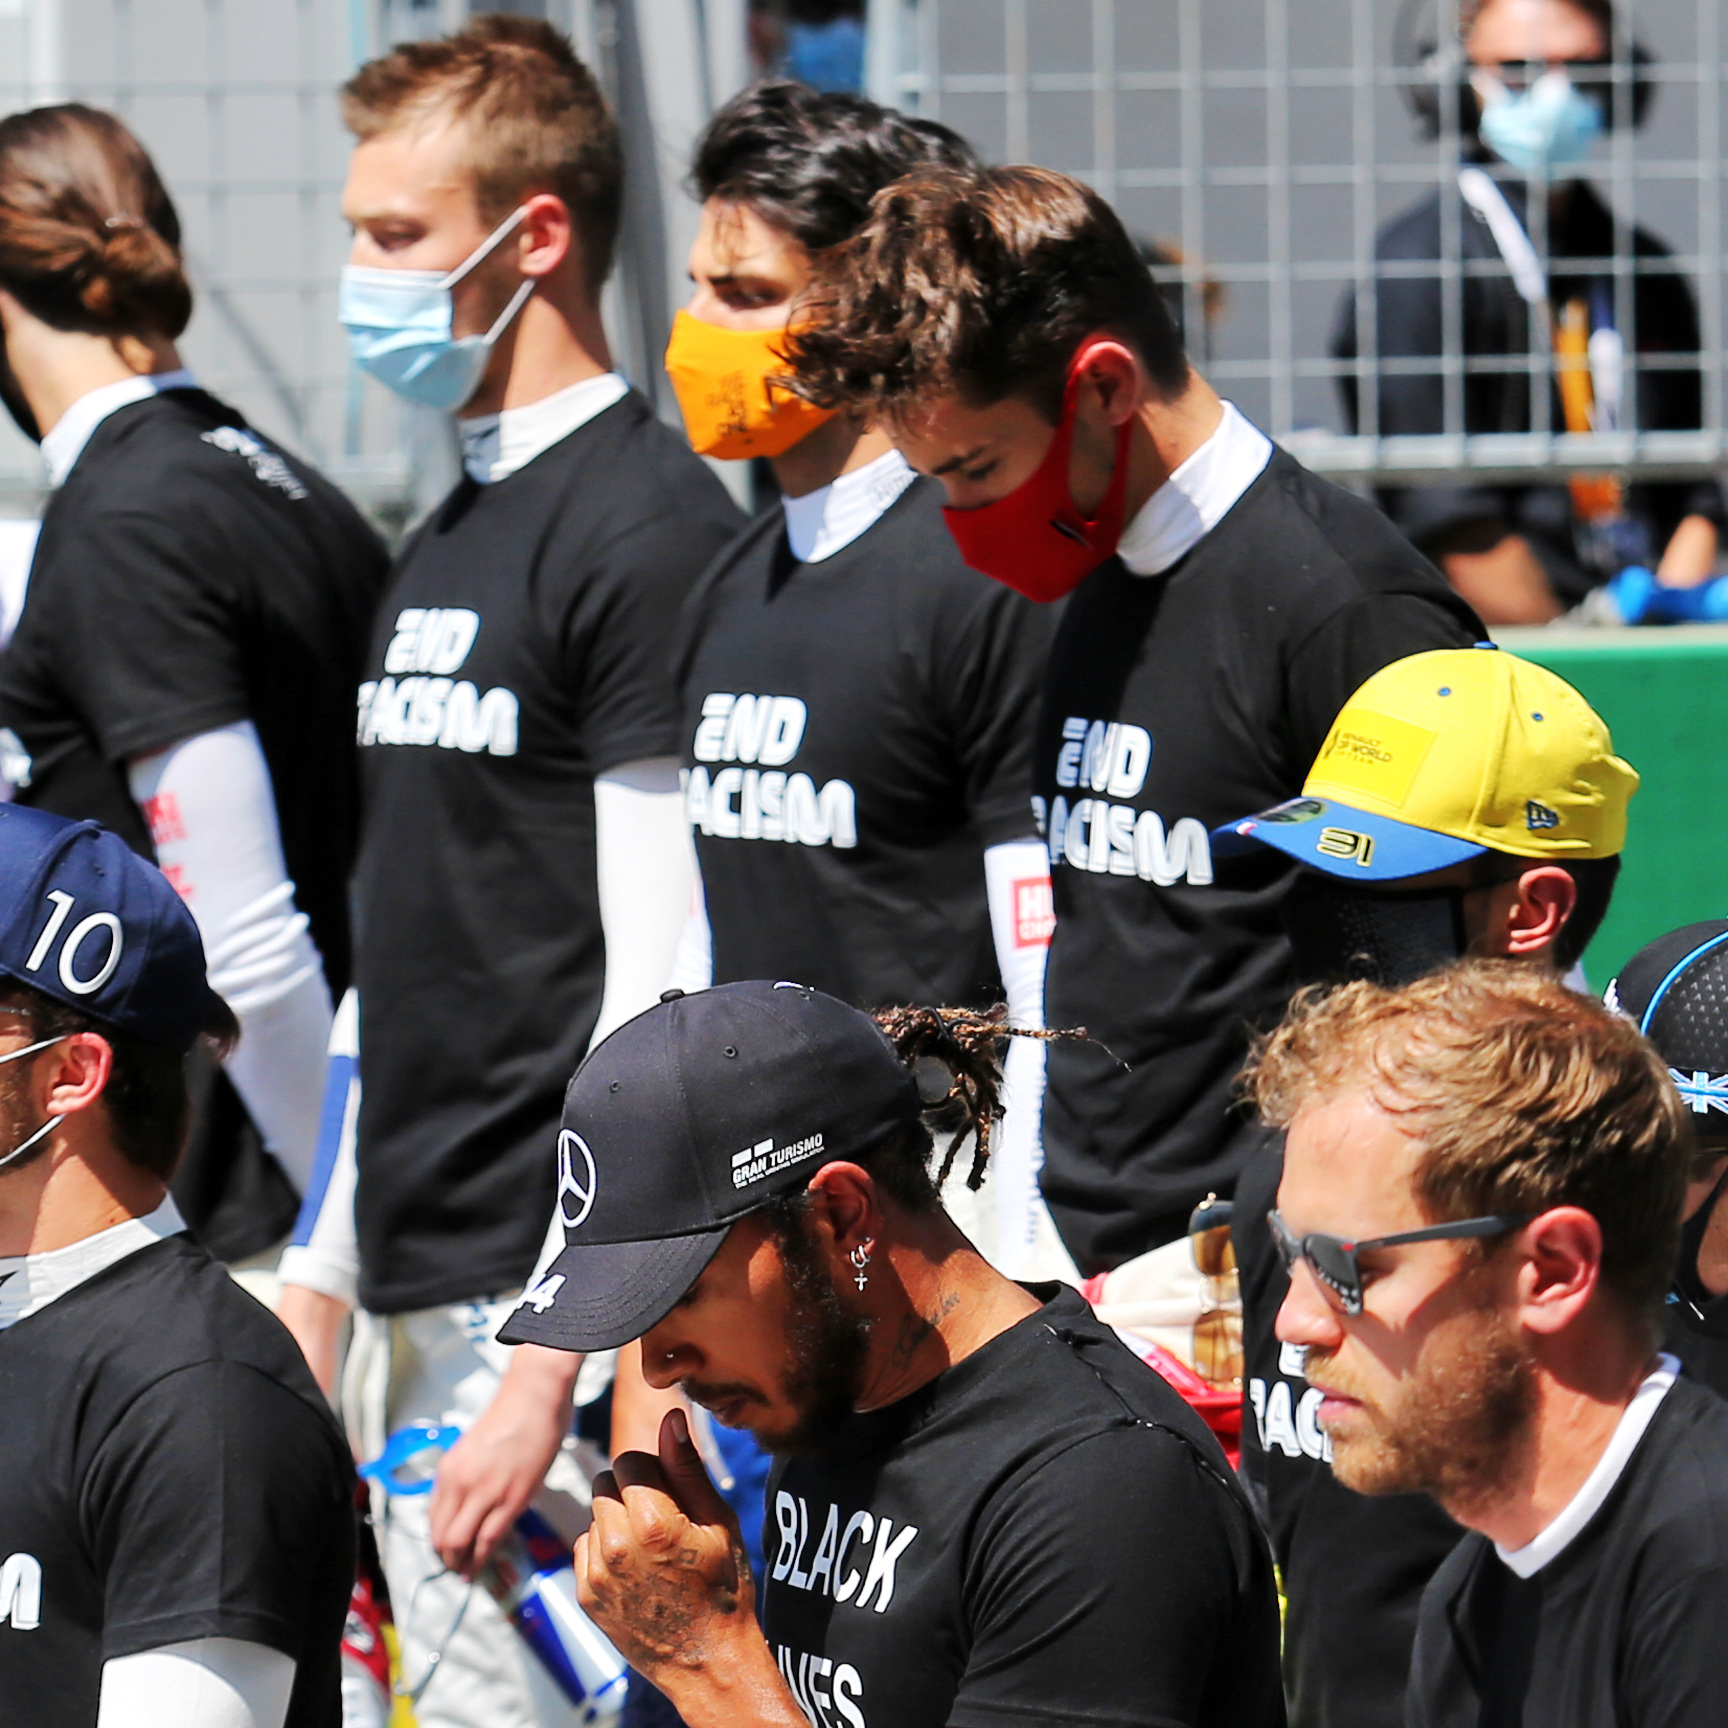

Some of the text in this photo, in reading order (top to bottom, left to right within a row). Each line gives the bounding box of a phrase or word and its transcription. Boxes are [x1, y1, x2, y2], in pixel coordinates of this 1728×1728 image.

[380, 606, 478, 677] END
[688, 692, 805, 766] END
[1052, 717, 1152, 799] END
[677, 764, 858, 848] ACISM
[1029, 795, 1214, 887] ACISM
[25, 888, 124, 995] 10
[733, 1132, 824, 1185] GRAN TURISMO
[772, 1489, 919, 1615] BLACK
